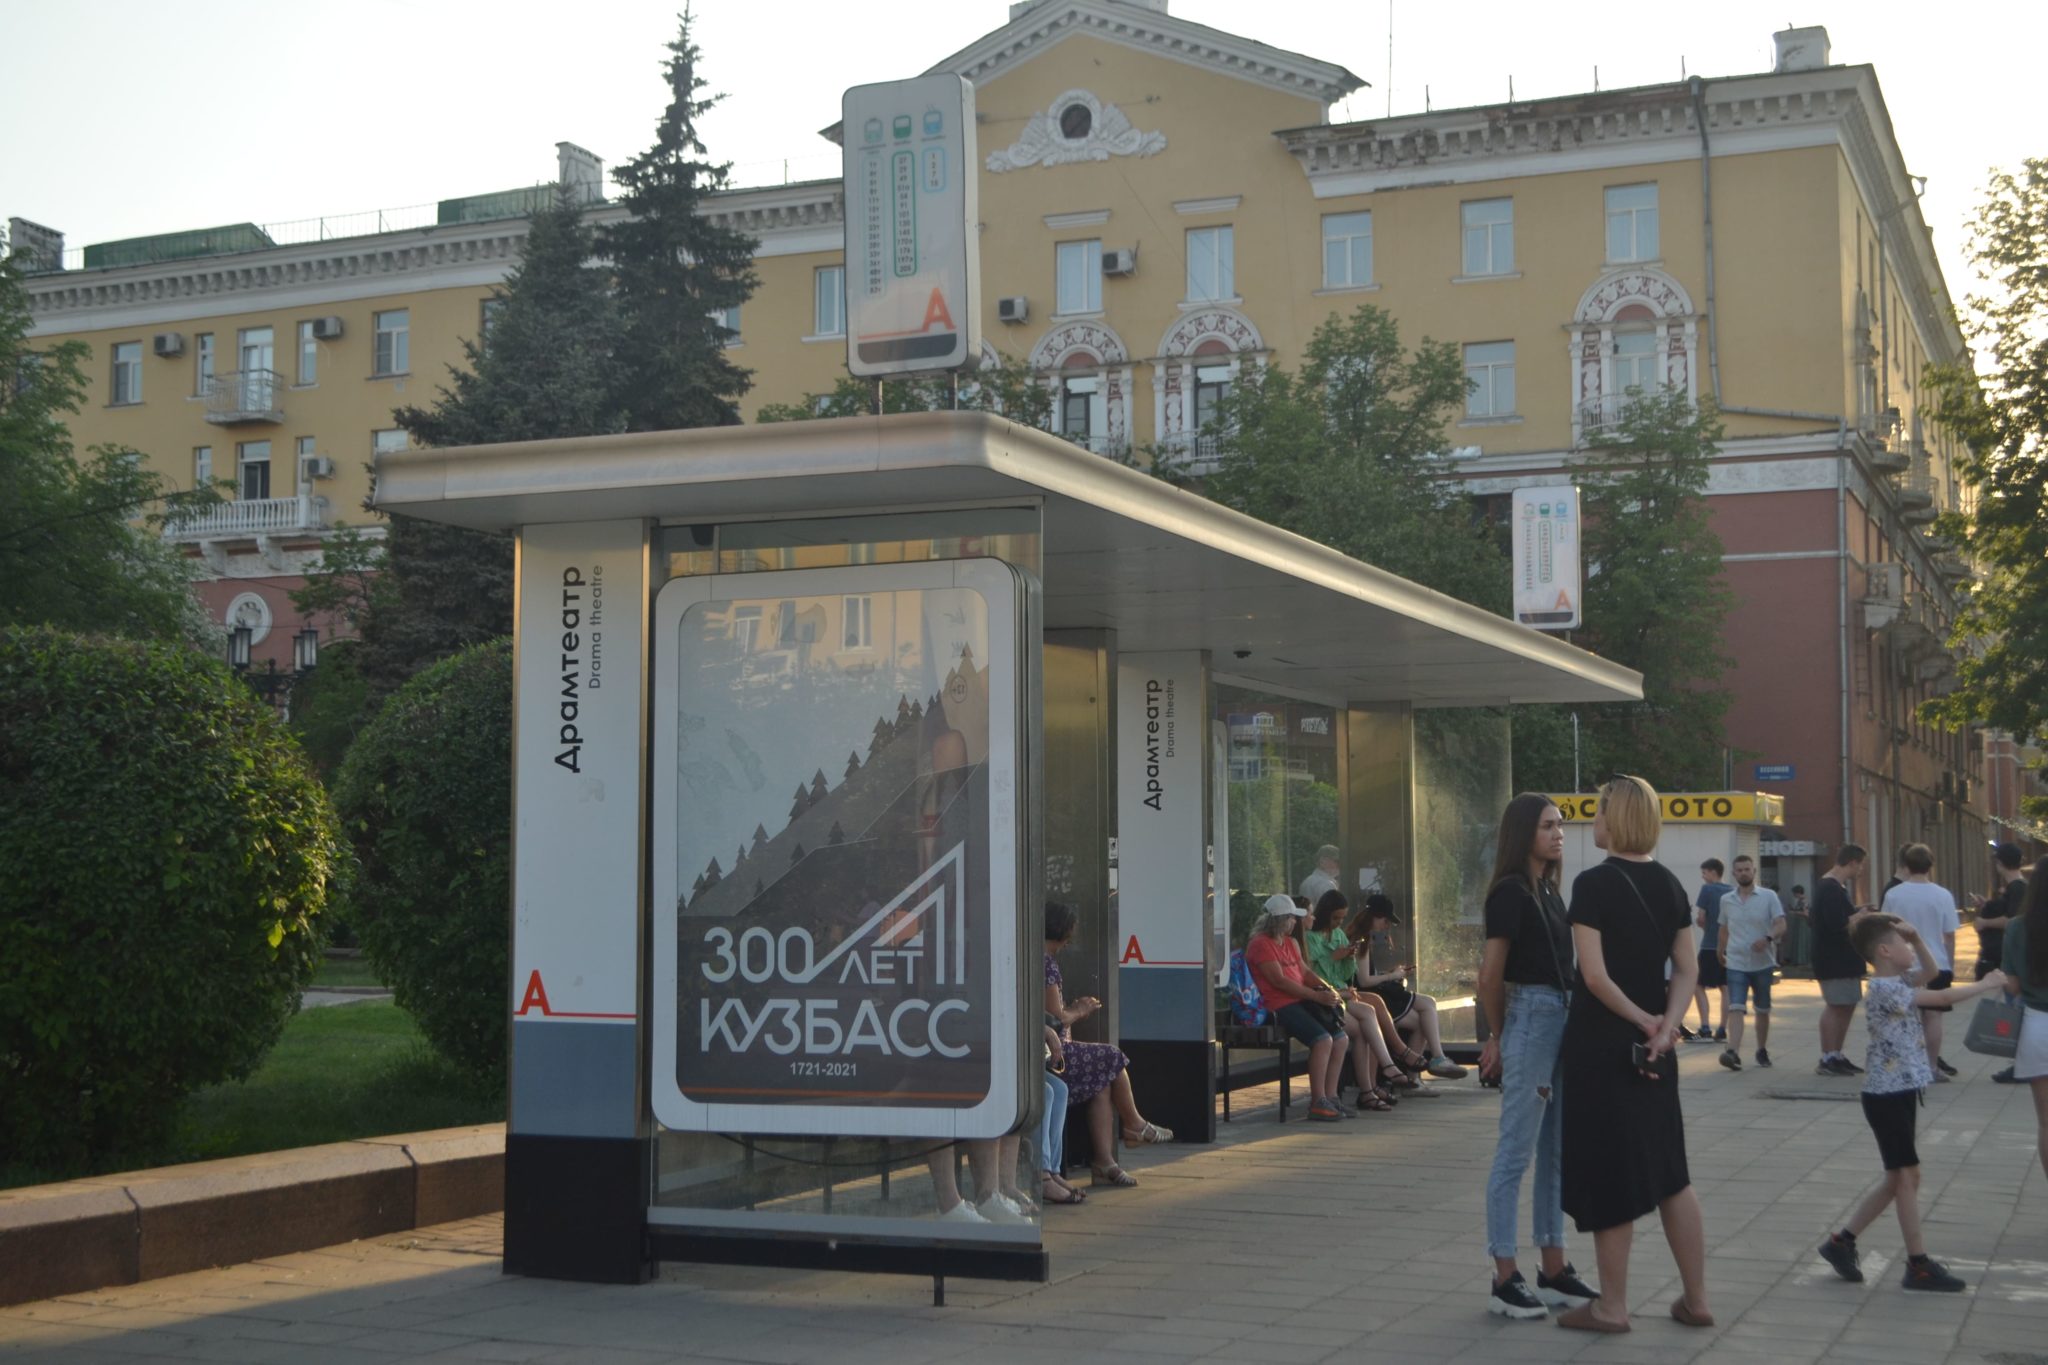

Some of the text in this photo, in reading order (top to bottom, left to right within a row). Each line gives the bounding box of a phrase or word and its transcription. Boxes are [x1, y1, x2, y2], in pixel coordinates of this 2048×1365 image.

[588, 565, 604, 690] Drama theatre
[554, 566, 586, 774] Драмтеатр
[1143, 679, 1163, 811] Драмтеатр
[1165, 679, 1175, 758] Drama theatre
[701, 926, 924, 984] 300 ЛЕТ
[1122, 934, 1145, 963] А
[520, 969, 552, 1015] А
[701, 998, 971, 1058] КУЗБАСС
[789, 1061, 857, 1077] 1721-2021
